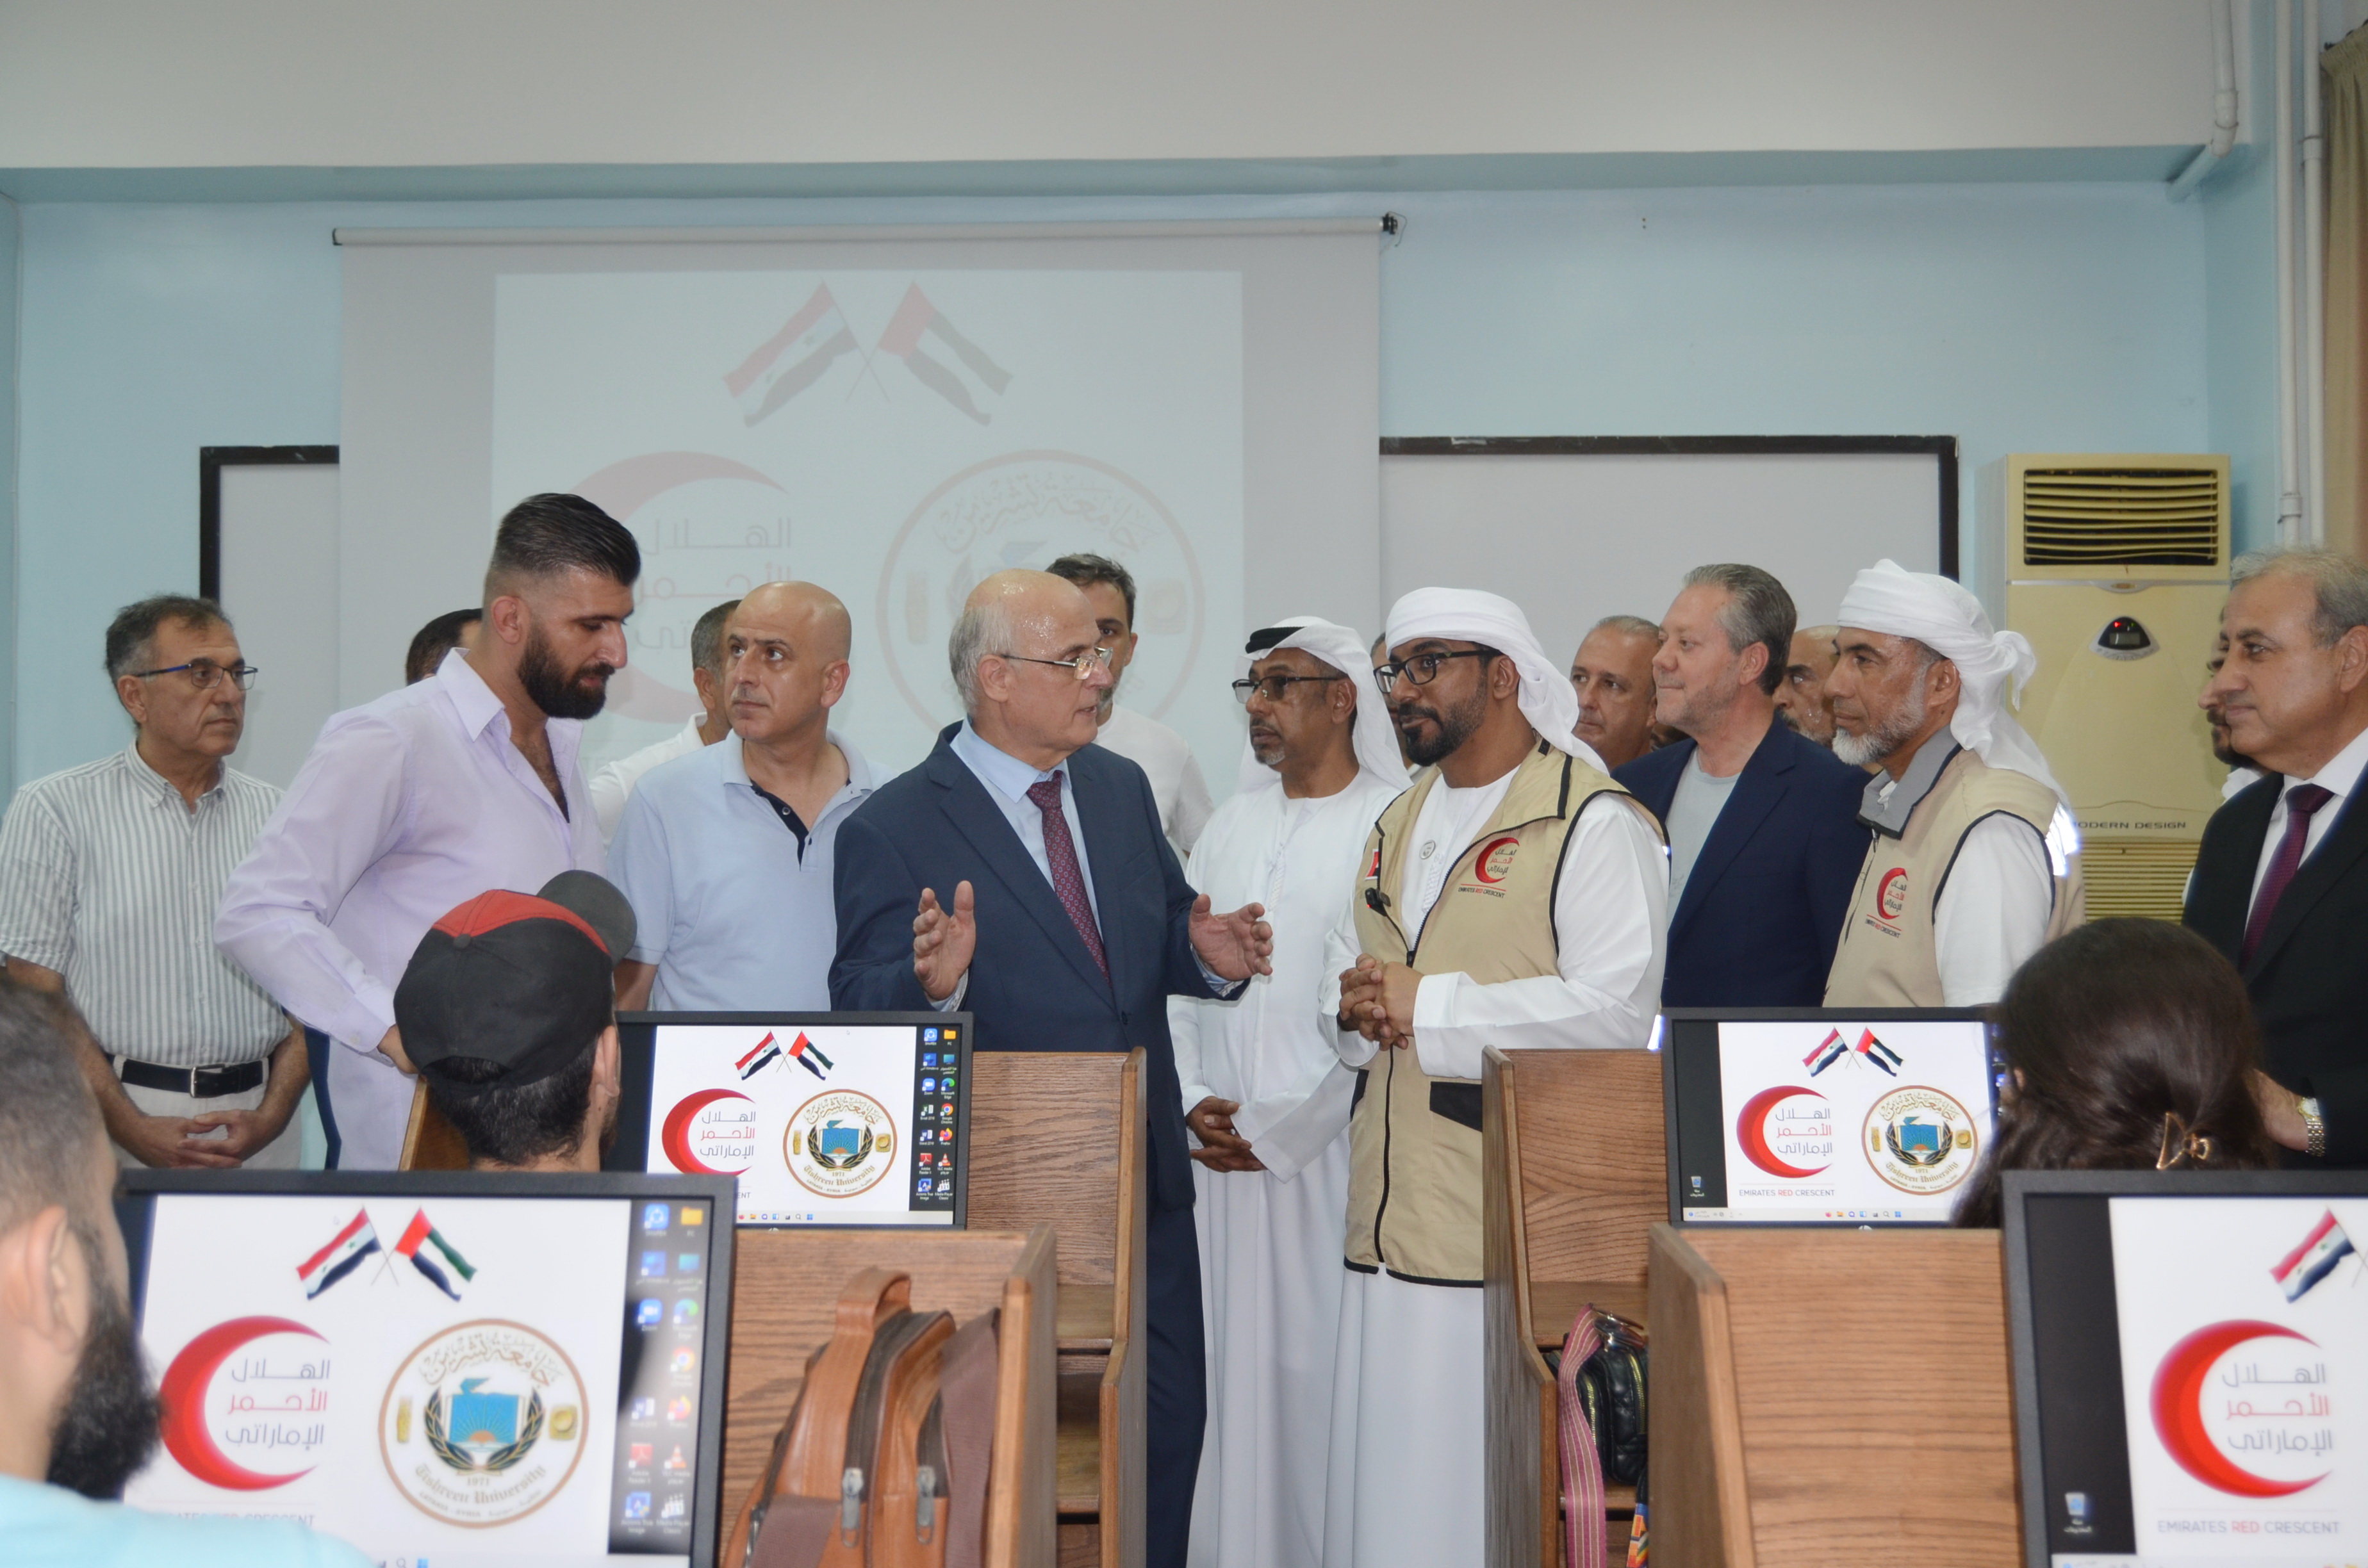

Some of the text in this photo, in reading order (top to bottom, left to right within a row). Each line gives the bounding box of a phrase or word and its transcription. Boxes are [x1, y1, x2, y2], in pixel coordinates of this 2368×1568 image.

[1483, 889, 1505, 898] CRESCENT
[702, 1111, 756, 1123] الهلال
[1775, 1108, 1830, 1121] الهلال
[700, 1126, 755, 1141] الأحمر
[1777, 1123, 1831, 1138] الأحمر
[700, 1145, 754, 1159] الإماراتي
[1777, 1142, 1832, 1156] الإماراتي
[804, 1164, 834, 1186] Tishreen
[836, 1165, 875, 1186] University
[1921, 1161, 1959, 1182] University
[231, 1358, 331, 1382] الهلال
[2222, 1362, 2326, 1387] الهلال
[227, 1387, 328, 1414] الأحمر
[2226, 1392, 2329, 1420] الأحمر
[225, 1423, 325, 1451] الإماراتي
[2228, 1428, 2333, 1457] الإماراتي
[416, 1463, 546, 1504] Tishreen University
[466, 1476, 489, 1486] 1971
[2158, 1521, 2340, 1533] EMIRATES RED CRESCENT
